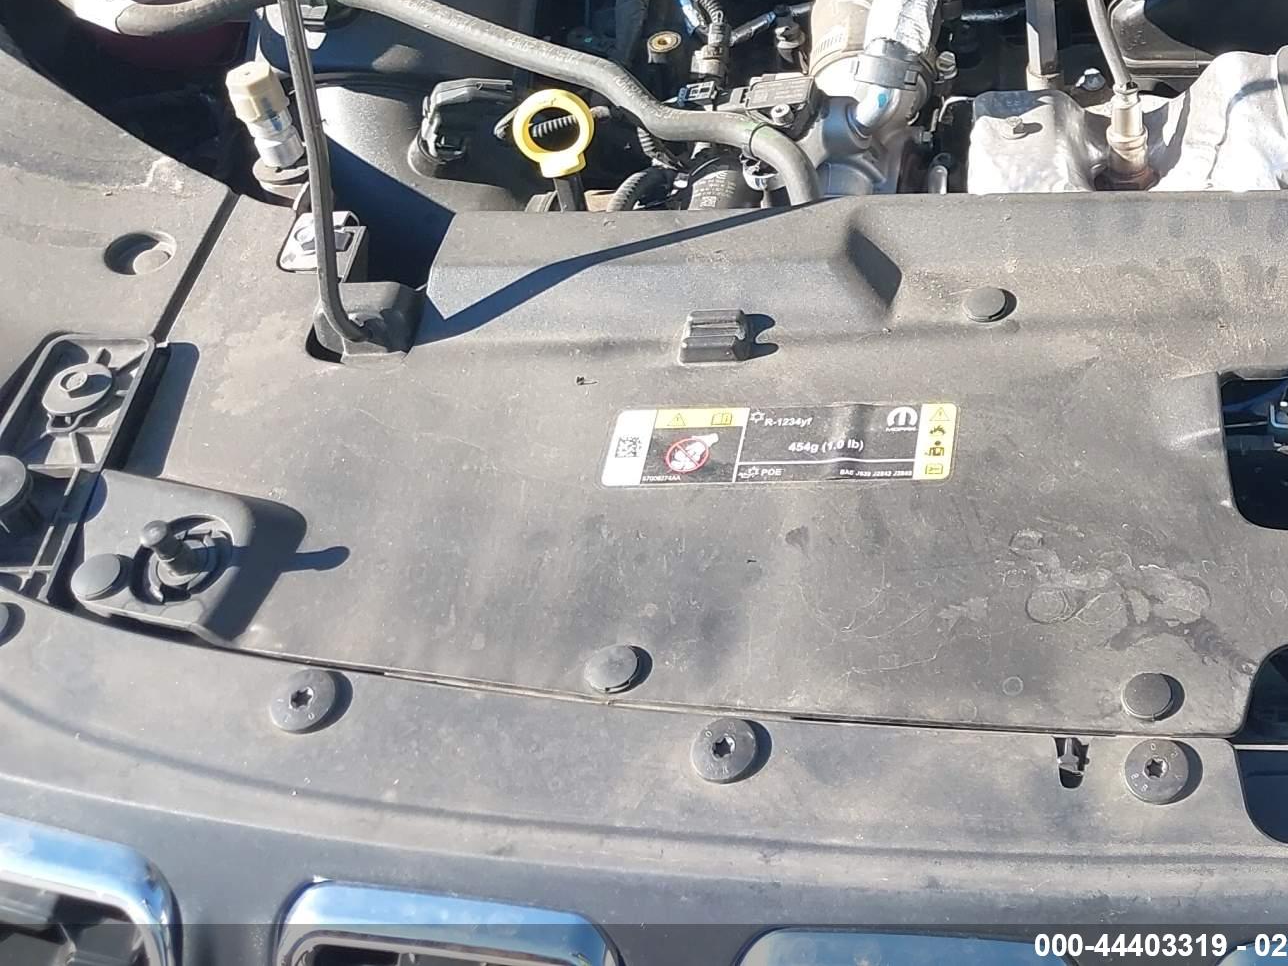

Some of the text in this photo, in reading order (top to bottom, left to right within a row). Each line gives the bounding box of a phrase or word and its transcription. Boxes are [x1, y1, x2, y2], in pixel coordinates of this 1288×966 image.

[764, 415, 813, 428] R-1234yf
[788, 438, 864, 453] 454g (1.0 lb)
[760, 468, 783, 477] POE
